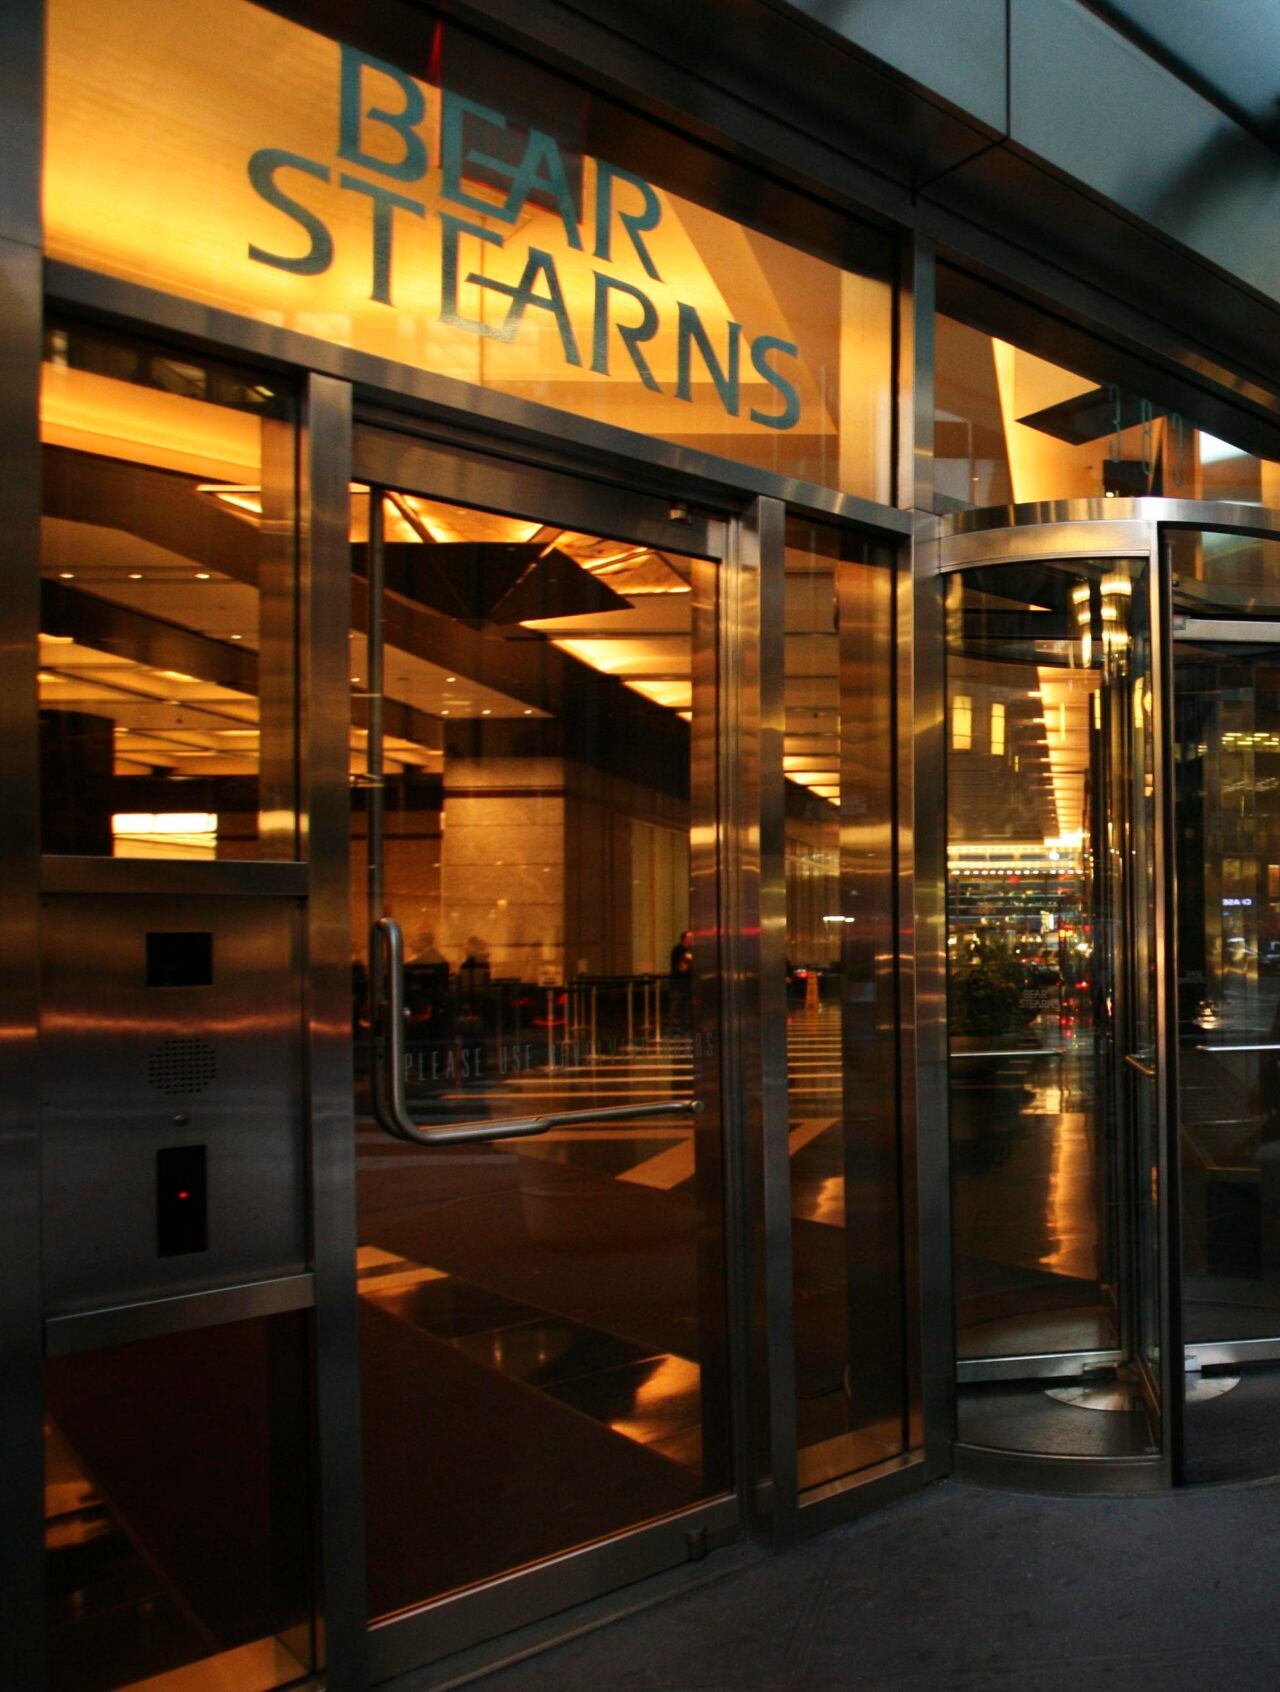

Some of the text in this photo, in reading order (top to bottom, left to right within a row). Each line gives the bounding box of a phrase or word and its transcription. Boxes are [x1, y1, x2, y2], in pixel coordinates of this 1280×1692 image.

[338, 41, 666, 285] BEAR
[247, 147, 801, 431] STEARNS
[403, 1048, 483, 1081] PLEASE
[499, 1044, 533, 1075] USE
